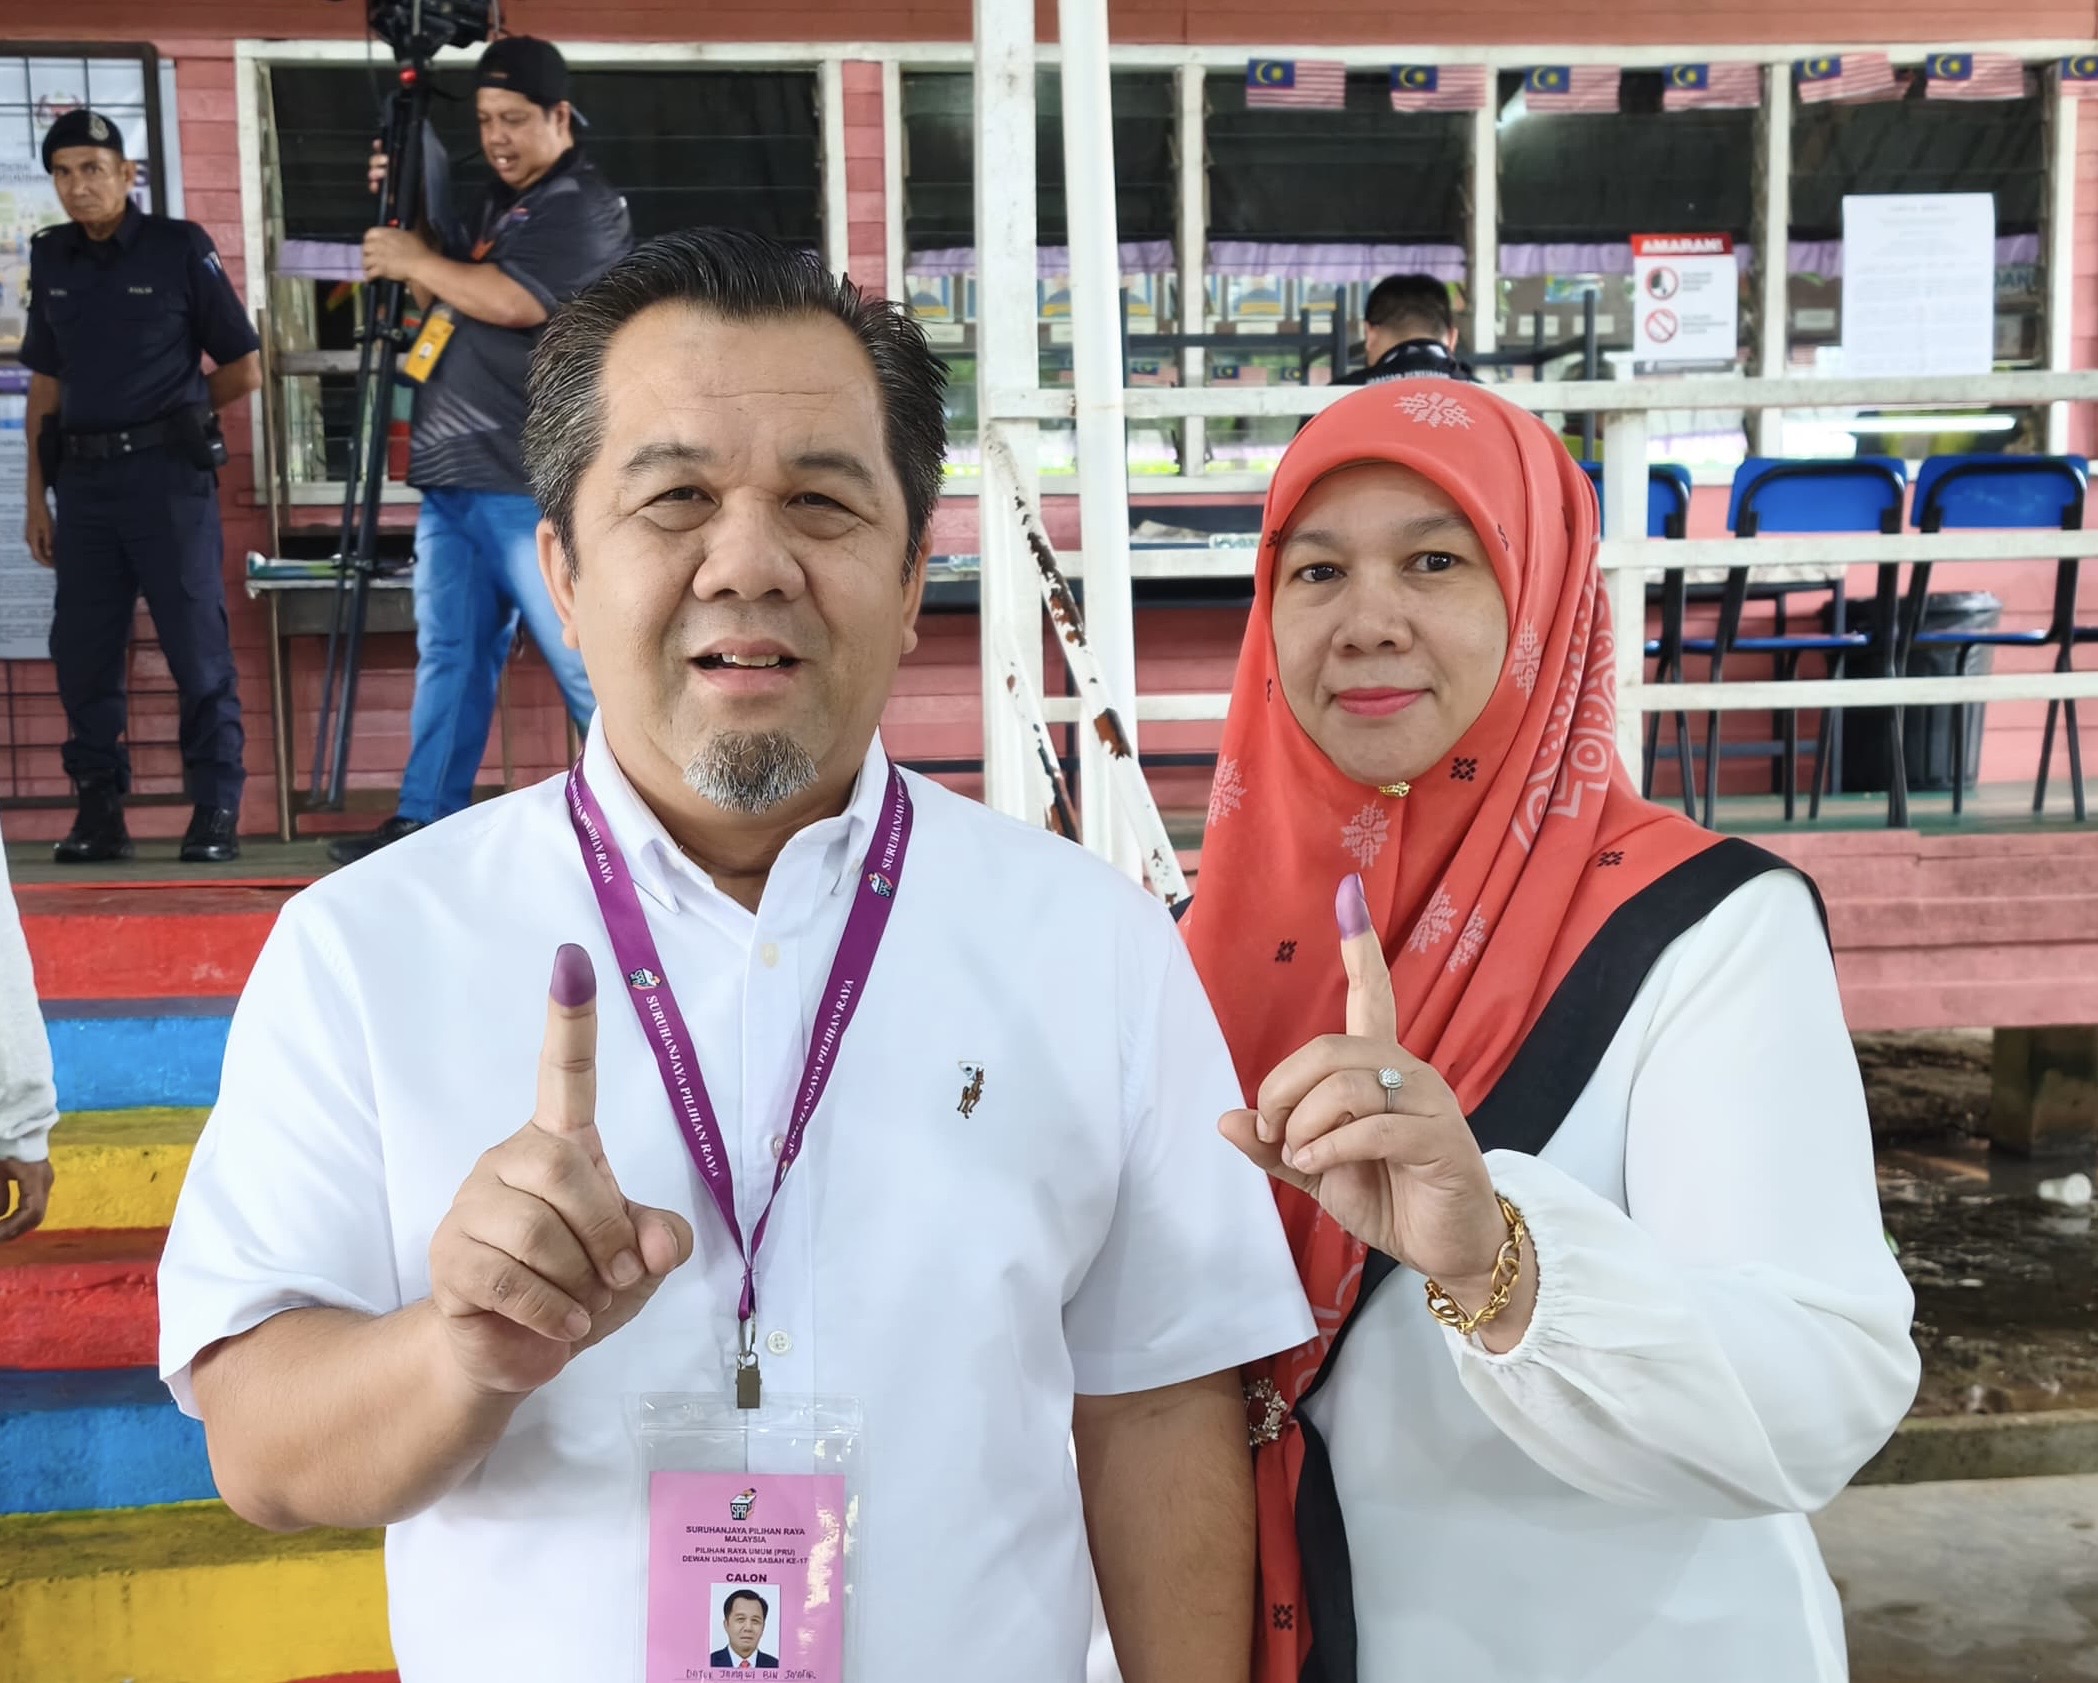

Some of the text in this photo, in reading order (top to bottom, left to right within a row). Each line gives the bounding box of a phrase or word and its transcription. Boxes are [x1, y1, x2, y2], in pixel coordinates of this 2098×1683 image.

[595, 852, 614, 884] RAYA
[817, 1011, 842, 1064] PILIHAN
[835, 979, 854, 1012] RAYA
[645, 995, 720, 1178] SURUHANJAYA PILIHAN RAYA
[731, 1504, 748, 1519] SPR
[685, 1526, 806, 1536] SURUHANJAYA PILIHAN RAYA
[774, 1549, 796, 1557] (PRU)
[682, 1555, 710, 1563] DEWAN
[726, 1573, 768, 1583] CALON
[762, 1670, 778, 1680] BIN
